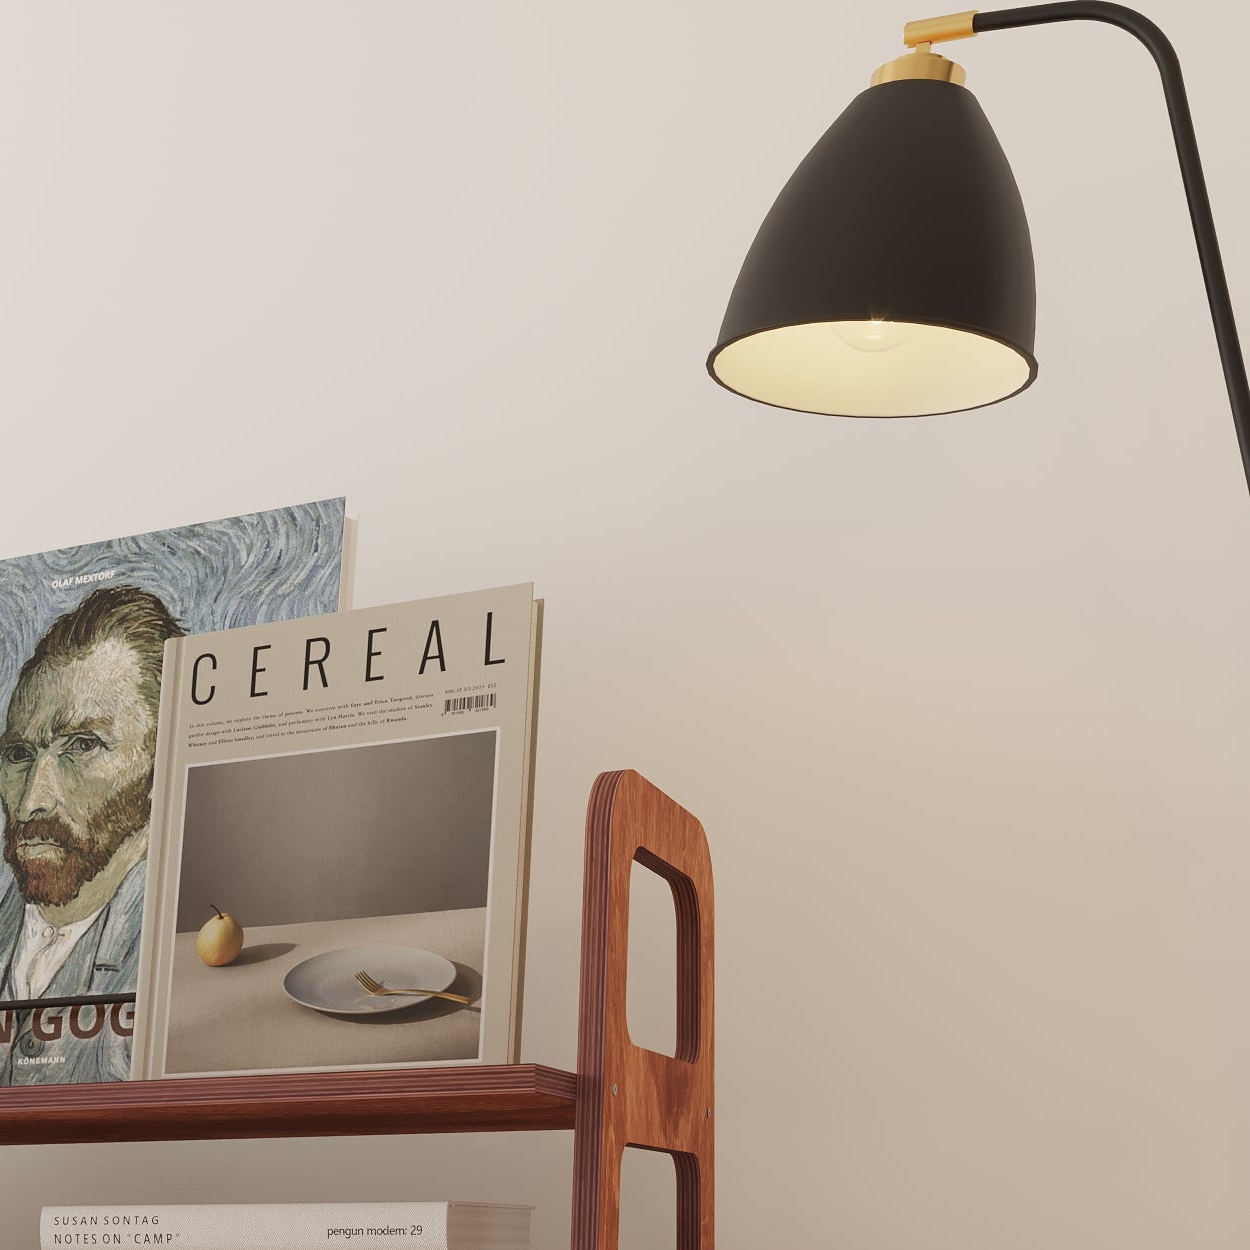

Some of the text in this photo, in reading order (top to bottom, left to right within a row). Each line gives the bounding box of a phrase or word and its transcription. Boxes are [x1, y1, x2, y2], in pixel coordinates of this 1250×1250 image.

[51, 570, 116, 589] OLAF MEXTORF
[190, 610, 507, 707] CEREAL
[234, 716, 251, 724] explore
[53, 1215, 160, 1226] SUSAN SONTAG
[410, 1225, 423, 1236] 29
[54, 1233, 98, 1245] NOTES
[102, 1233, 122, 1245] ON
